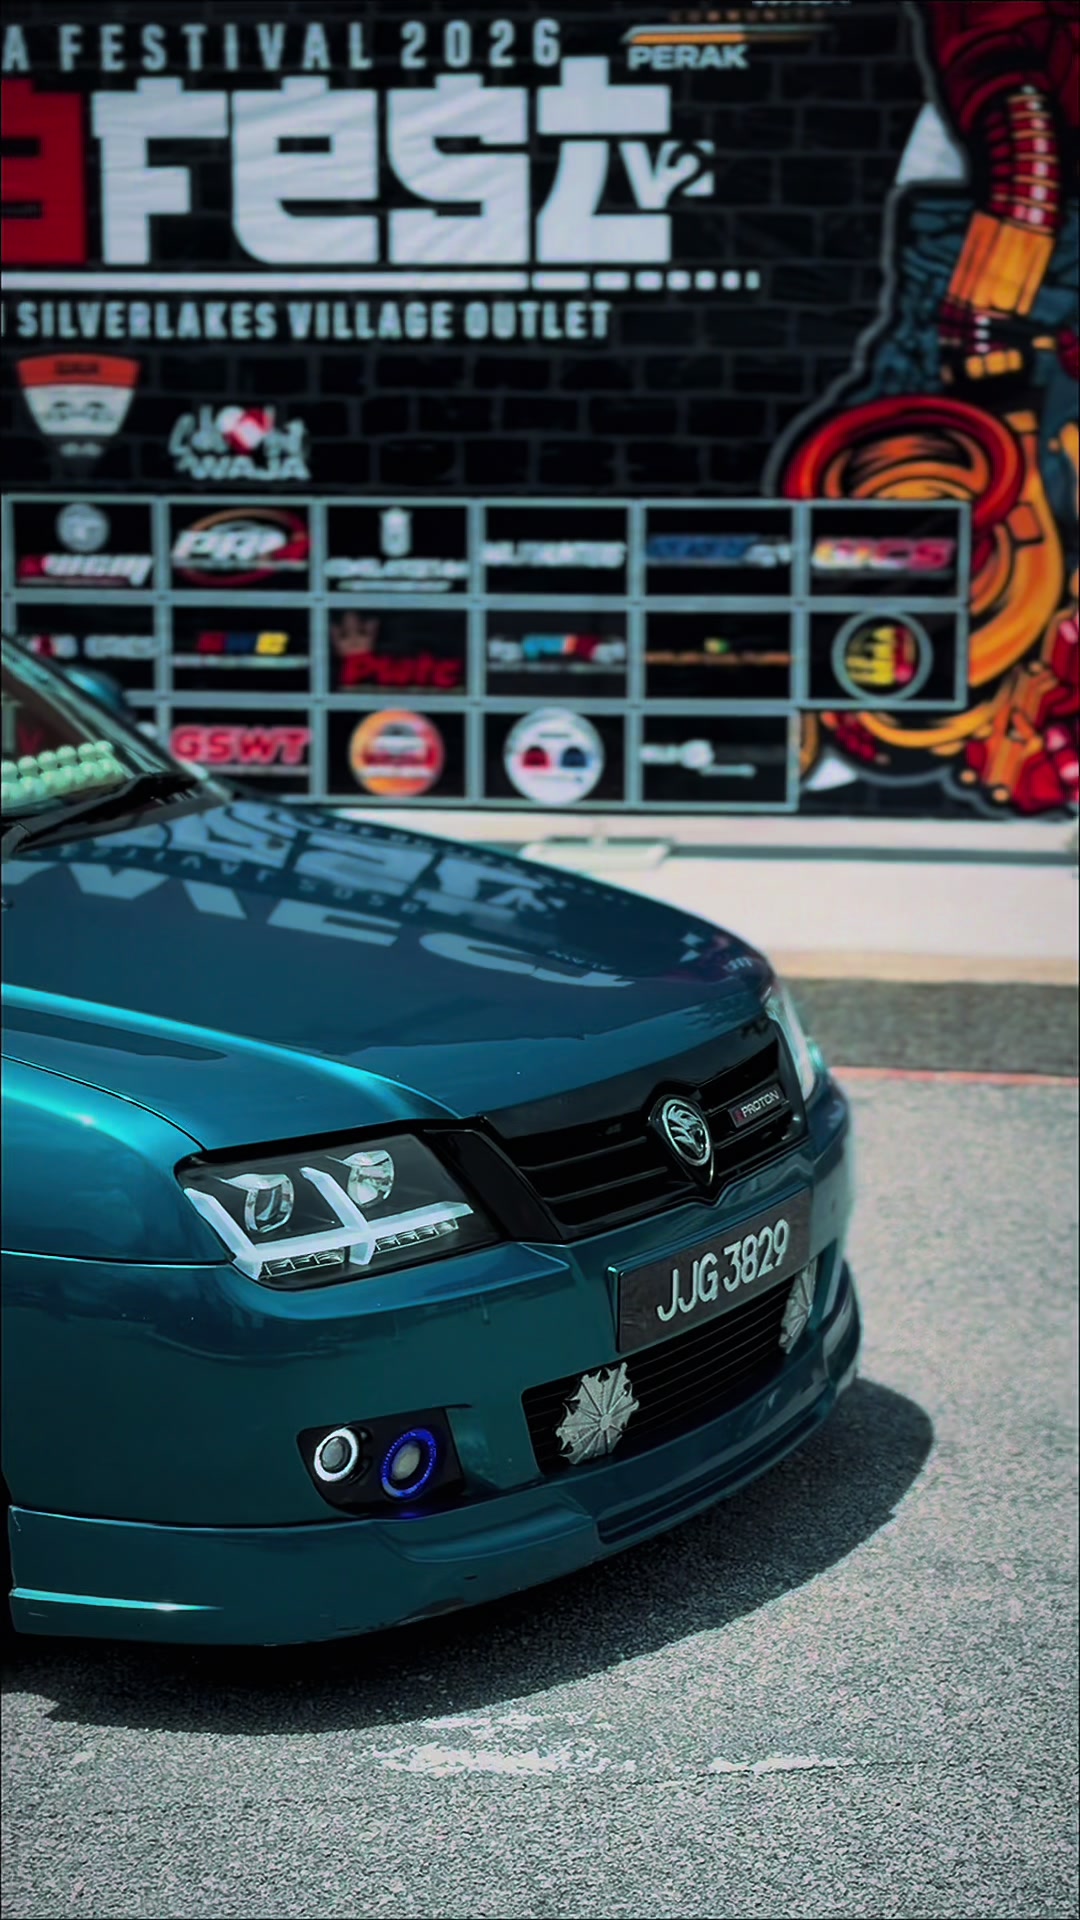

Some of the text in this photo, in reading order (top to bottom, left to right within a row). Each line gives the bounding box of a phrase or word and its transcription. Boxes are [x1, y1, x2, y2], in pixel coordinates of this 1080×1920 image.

[59, 23, 373, 71] FESTIVAL
[400, 19, 560, 68] 2026
[628, 44, 749, 70] PERAK
[16, 301, 278, 339] SILVERLAKES
[287, 301, 454, 339] VILLAGE
[464, 301, 611, 338] OUTLET
[170, 725, 312, 764] GSWT
[741, 1089, 780, 1118] PROTON
[657, 1218, 790, 1322] JJG 3829
